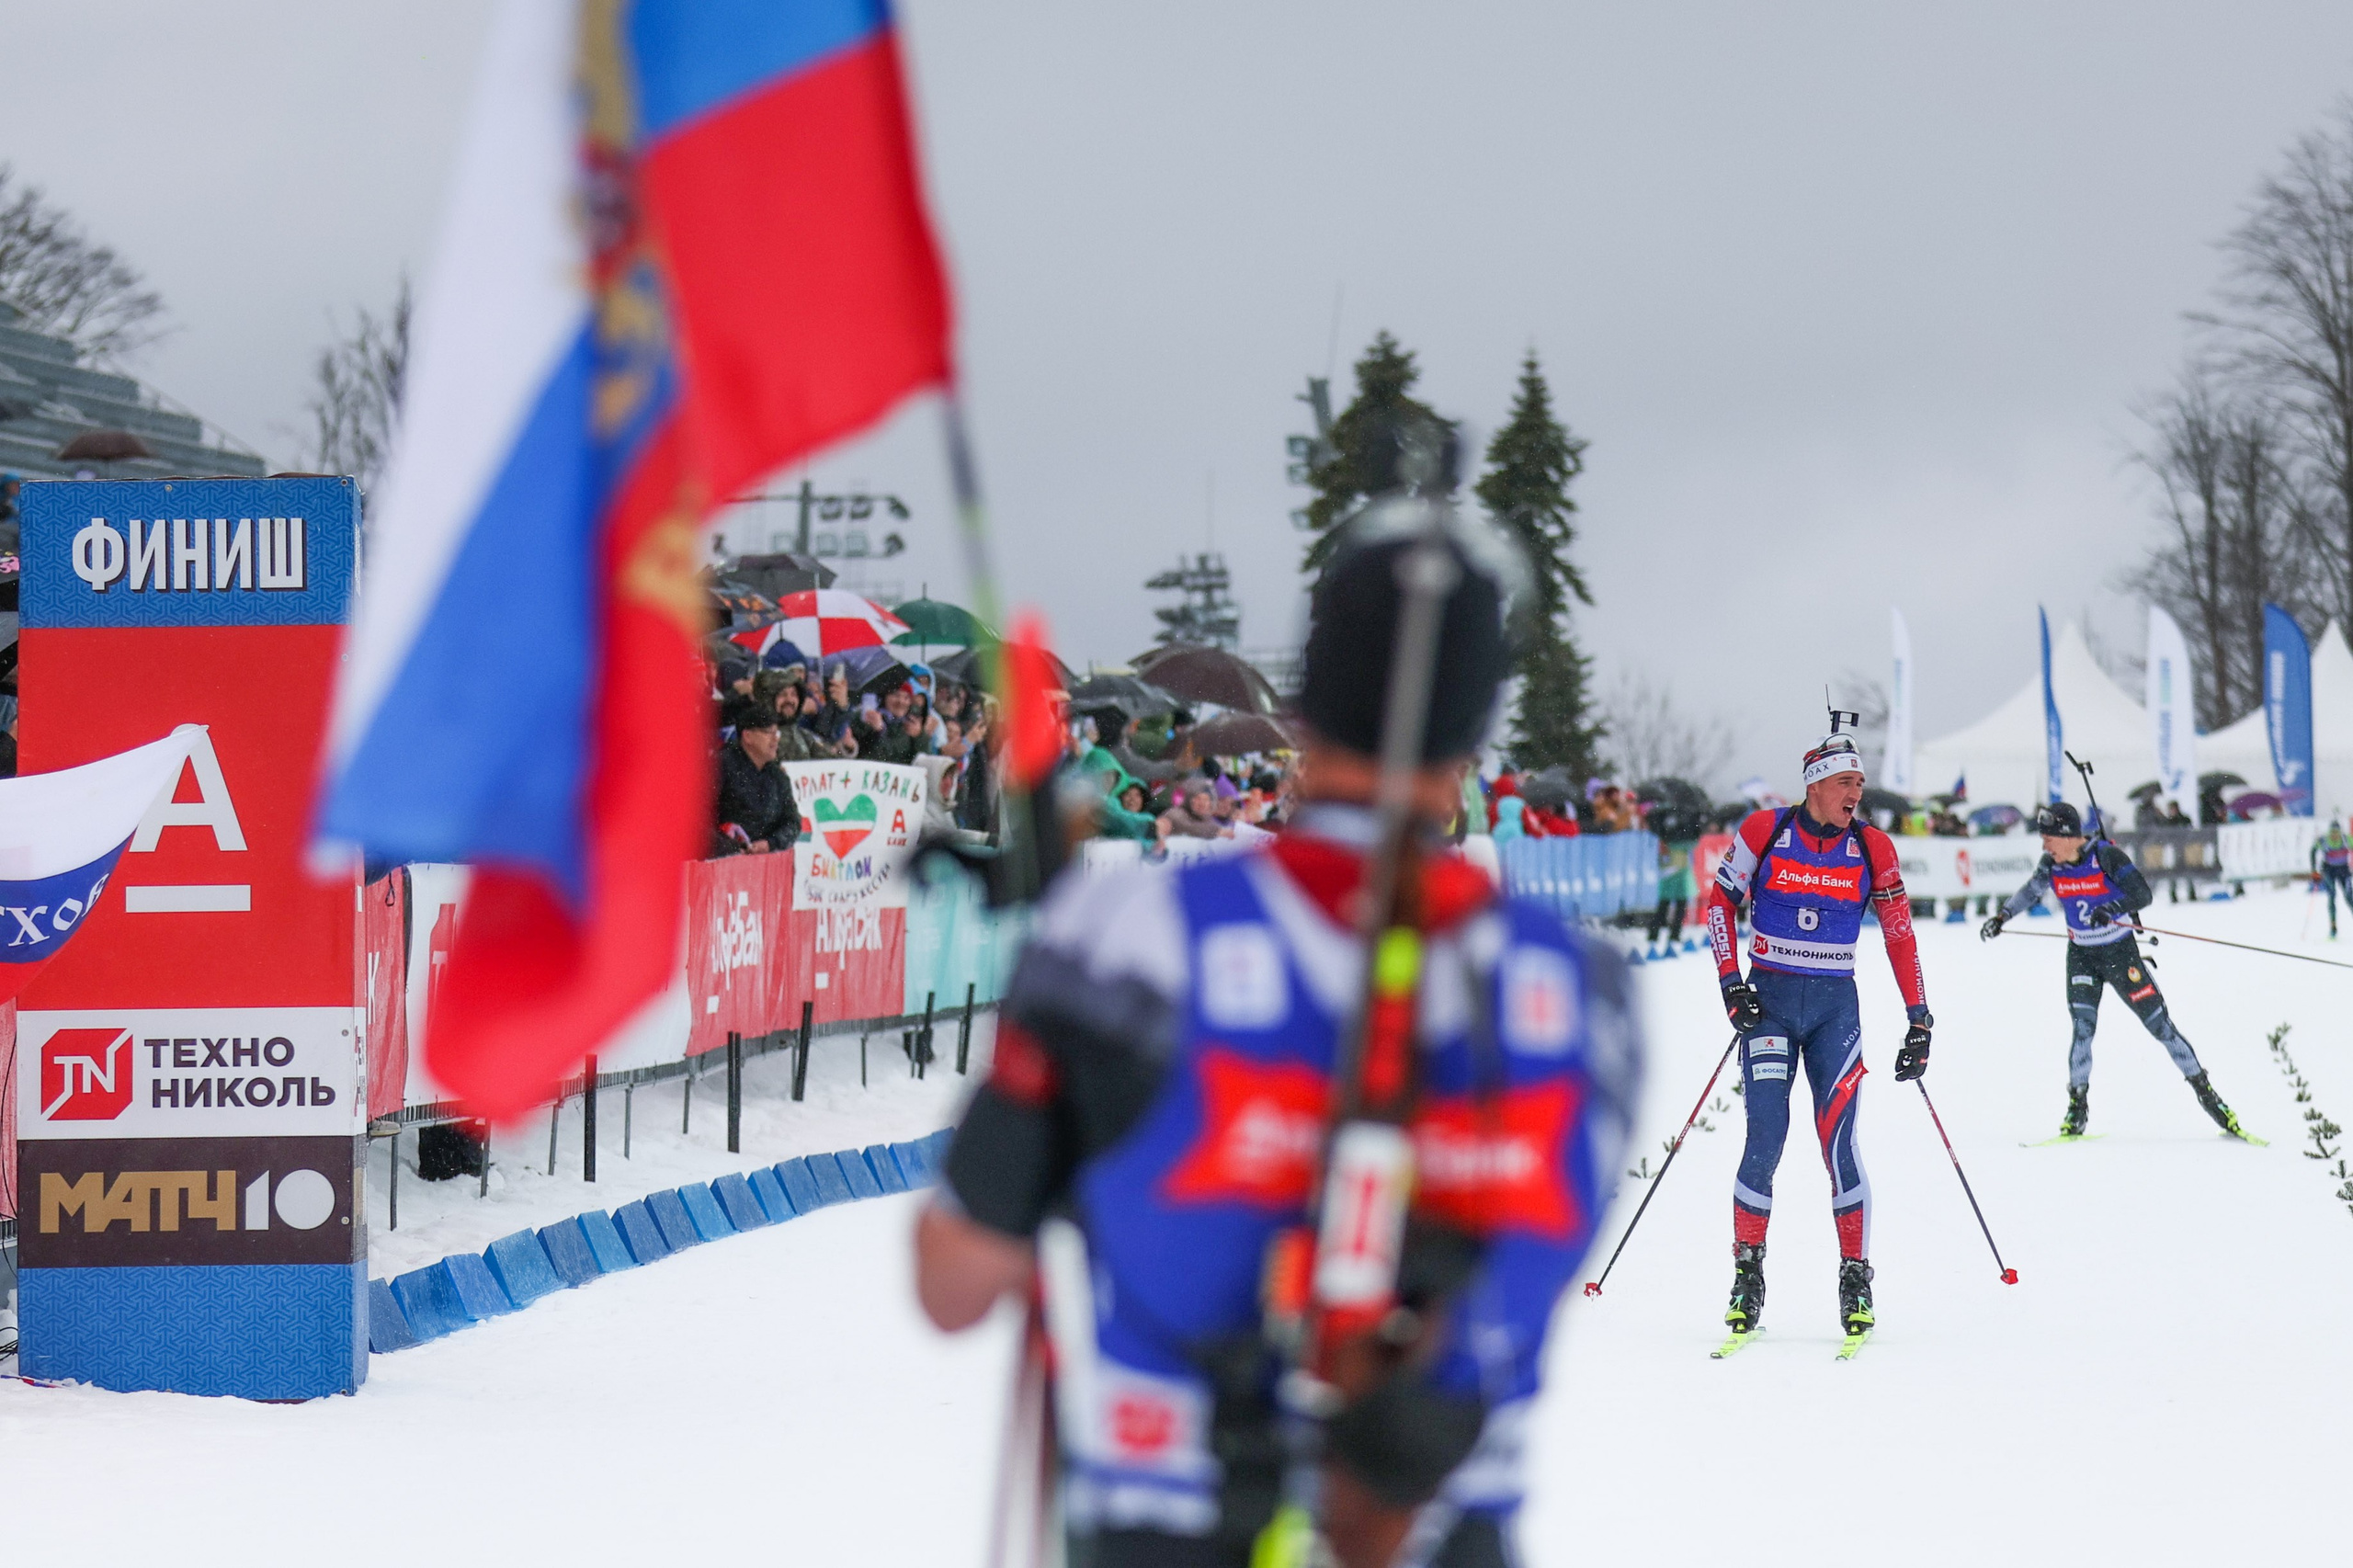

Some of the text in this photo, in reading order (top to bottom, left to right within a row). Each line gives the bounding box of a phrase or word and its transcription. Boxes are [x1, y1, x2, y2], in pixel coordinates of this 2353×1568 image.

[72, 517, 307, 592] ФИНИШ
[862, 769, 920, 803] КАЗАНЬ
[892, 808, 906, 834] А
[1777, 869, 1854, 889] Альфа Банк
[0, 873, 109, 947] ХОВ
[1797, 906, 1820, 931] 6
[2075, 900, 2092, 926] 2
[1770, 944, 1855, 961] ТЕХНОНИКОЛЬ
[143, 1036, 296, 1068] ТЕХНО
[151, 1076, 337, 1108] НИКОЛЬ
